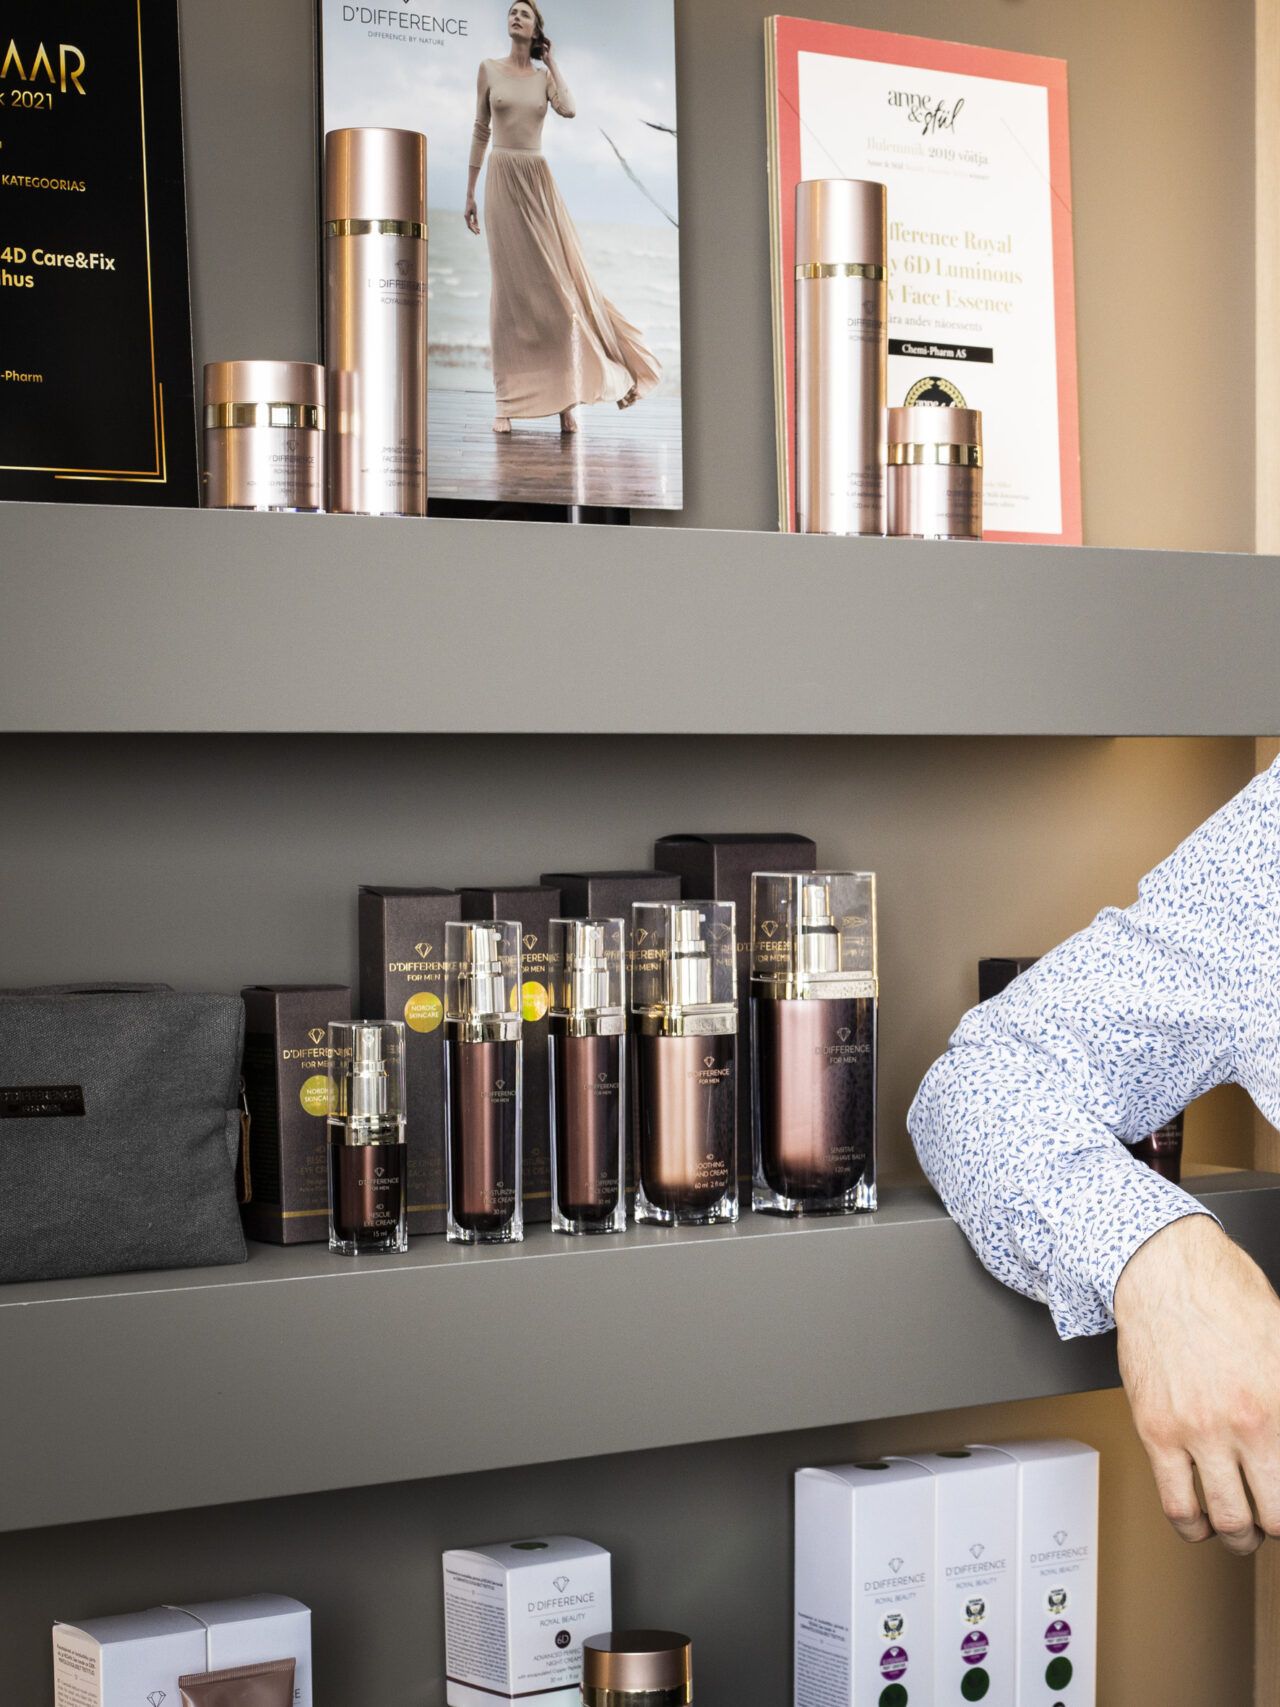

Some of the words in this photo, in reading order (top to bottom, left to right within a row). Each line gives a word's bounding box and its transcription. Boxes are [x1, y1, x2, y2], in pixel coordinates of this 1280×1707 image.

[367, 30, 407, 42] DIFFERENCE
[408, 34, 417, 43] BY
[418, 36, 445, 46] NATURE
[11, 89, 53, 111] 2021
[928, 146, 956, 162] 2019
[2, 174, 87, 192] KATEGOORIAS
[889, 221, 959, 248] fference
[963, 230, 1013, 257] Royal
[0, 247, 27, 264] 4D
[31, 249, 116, 271] Care&Fix
[903, 254, 931, 275] 6D
[935, 257, 1024, 285] Luminous
[0, 268, 35, 289] hus
[901, 284, 941, 307] Face
[945, 288, 1014, 314] Essence
[901, 343, 955, 359] Chemi-Pharm
[955, 348, 968, 359] AS
[407, 974, 423, 982] FOR
[424, 973, 441, 981] MEN
[408, 1012, 439, 1020] SKINCARE
[411, 1004, 437, 1012] NORDIC
[301, 1061, 316, 1069] FOR
[829, 1056, 842, 1065] FOR
[843, 1056, 858, 1064] MEN
[709, 1168, 729, 1177] CREAM
[375, 1219, 396, 1227] CREAM
[539, 1617, 561, 1627] ROYAL
[561, 1612, 586, 1624] BEAUTY
[556, 1633, 570, 1645] 6D
